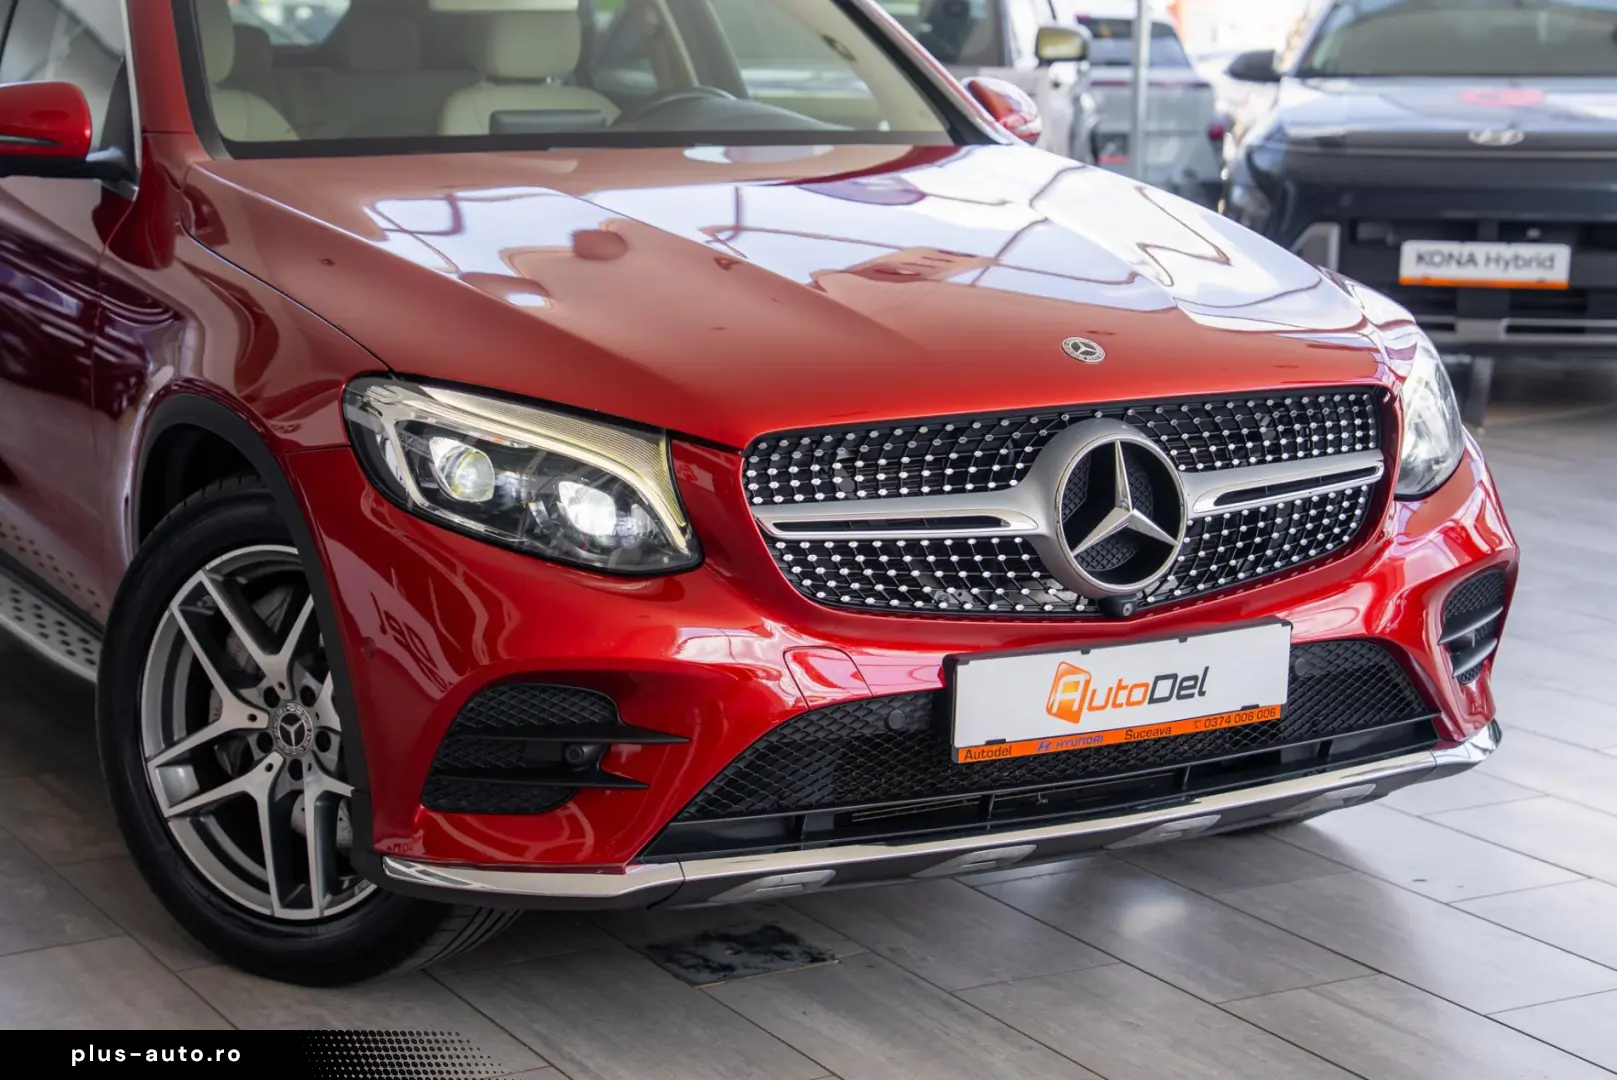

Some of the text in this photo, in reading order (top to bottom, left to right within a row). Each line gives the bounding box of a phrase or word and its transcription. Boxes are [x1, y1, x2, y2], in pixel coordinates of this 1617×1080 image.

[1416, 250, 1555, 272] KONA Hybrid
[1050, 666, 1210, 714] AutoDel
[963, 708, 1276, 761] Autodel HYUNDAI Suceava 0374 006 006
